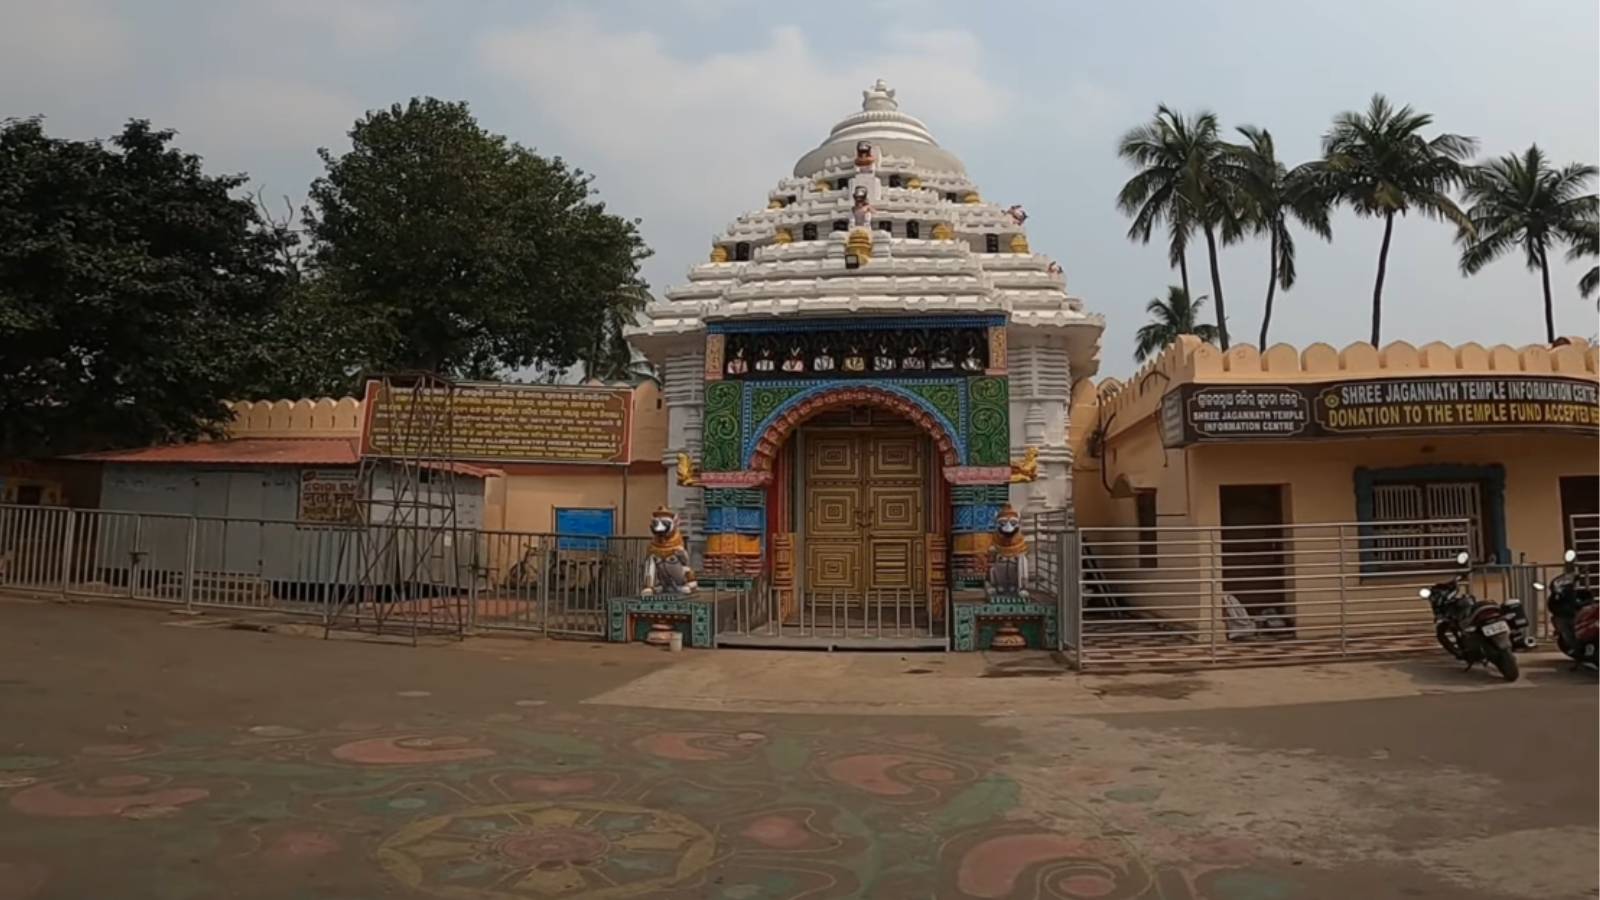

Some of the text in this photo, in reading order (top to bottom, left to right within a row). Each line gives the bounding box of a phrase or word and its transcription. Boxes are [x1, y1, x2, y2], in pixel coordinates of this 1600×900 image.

[1342, 385, 1382, 405] SHREE
[1386, 382, 1458, 402] JAGANNATH
[1461, 381, 1506, 400] TEMPLE
[1508, 381, 1572, 400] INFORMATION
[1193, 410, 1304, 420] SHREE JAGANNATH TEMPLE
[1329, 406, 1399, 427] DONATION
[1403, 405, 1422, 423] TO
[1425, 404, 1454, 423] THE
[1456, 403, 1507, 422] TEMPLE
[1510, 403, 1542, 421] FUND
[1545, 403, 1590, 422] ACCEPTED
[1204, 422, 1294, 431] INFORMATION CENTRE
